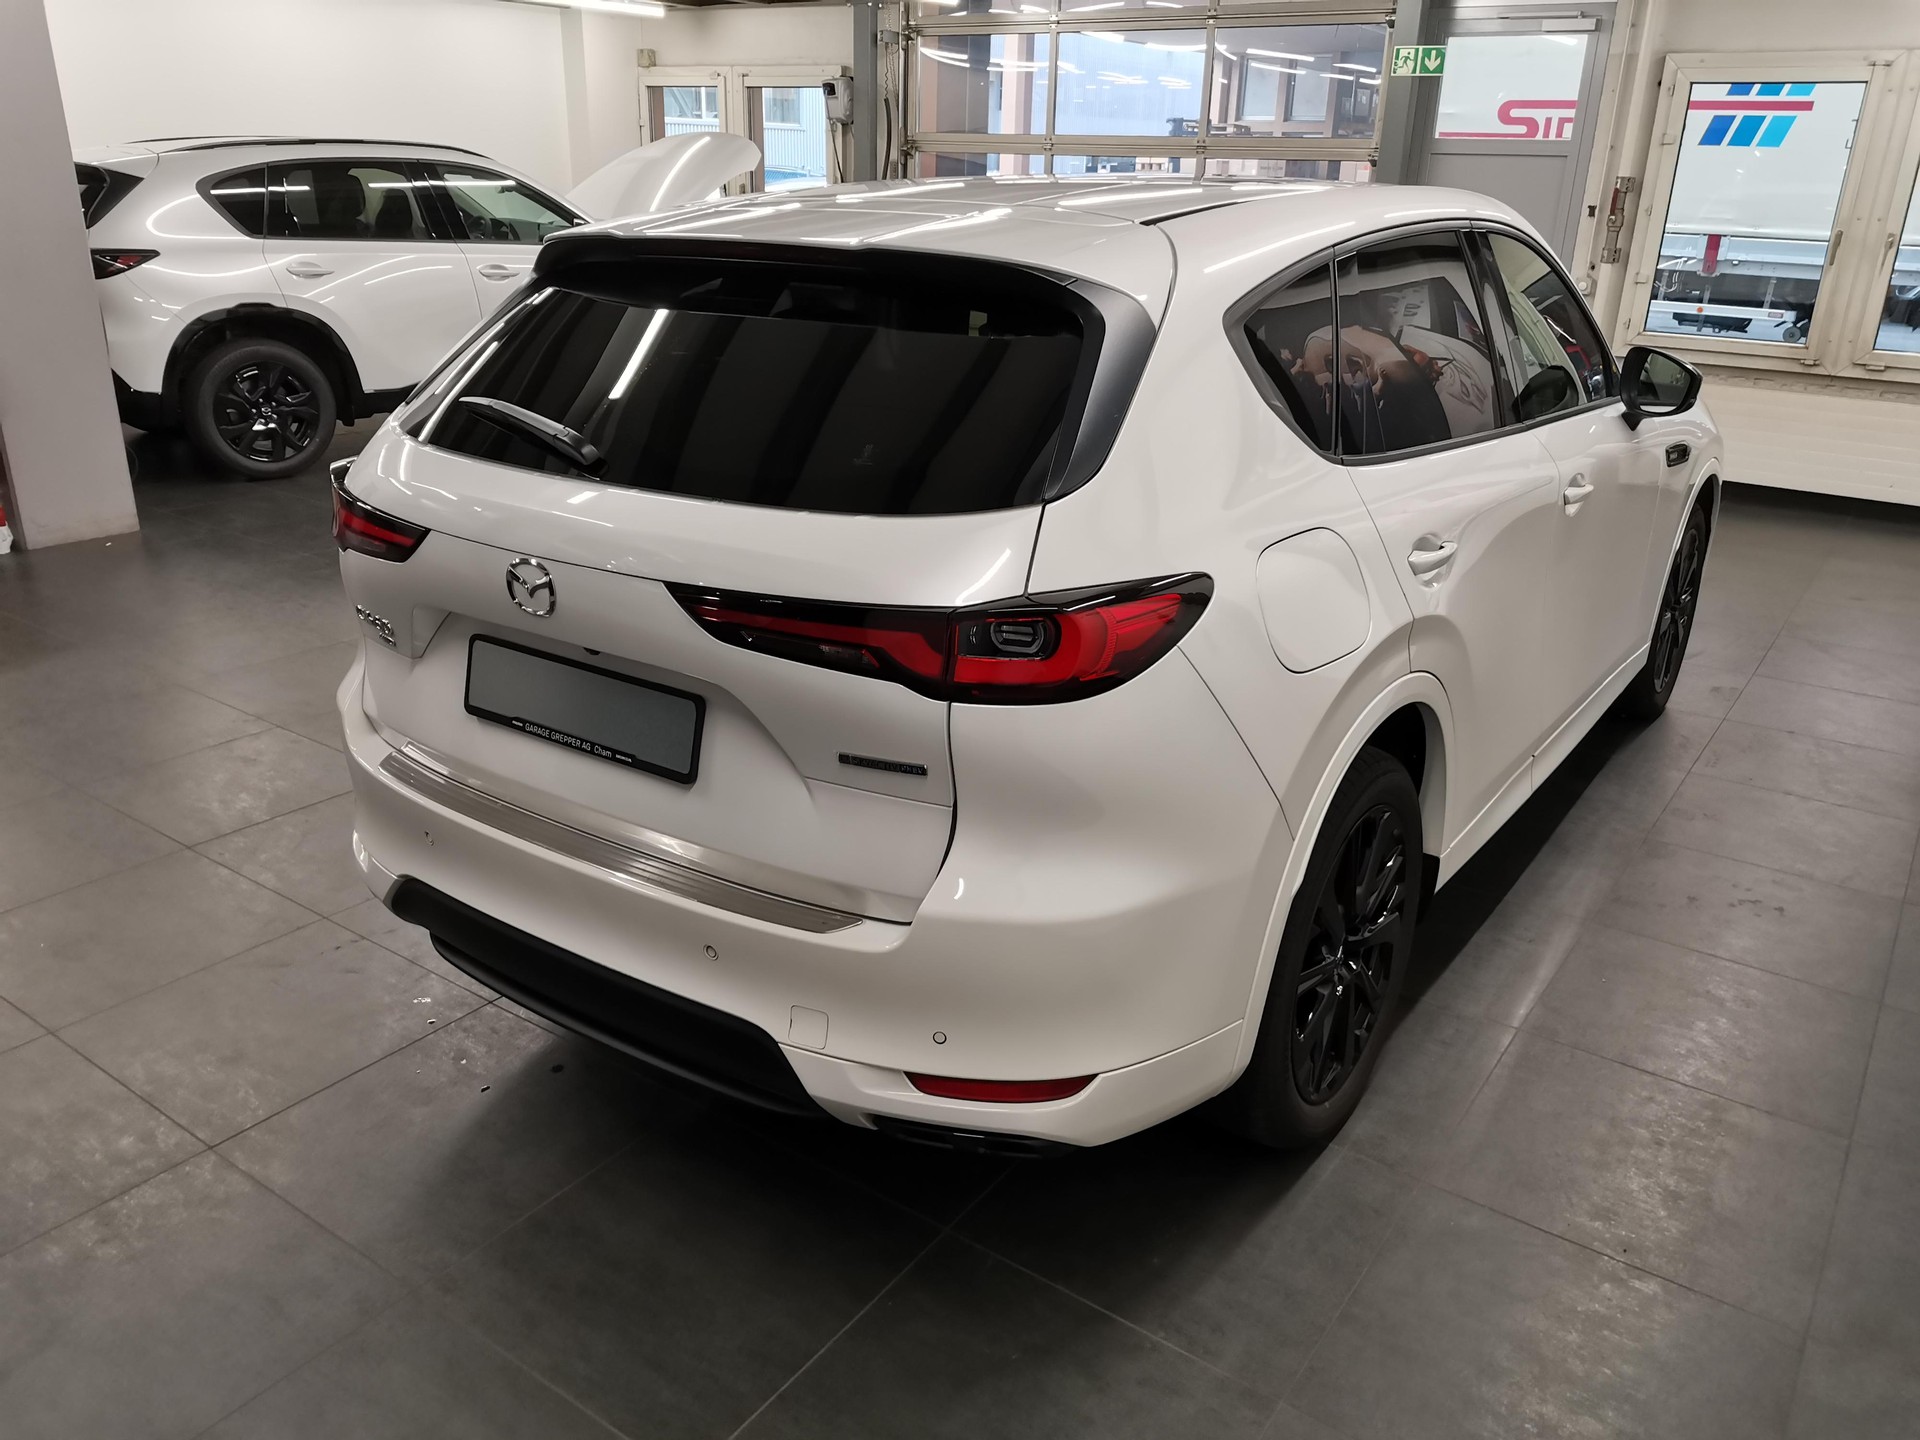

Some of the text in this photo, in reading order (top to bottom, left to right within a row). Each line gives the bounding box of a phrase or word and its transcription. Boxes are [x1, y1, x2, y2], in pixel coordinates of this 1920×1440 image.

[524, 722, 550, 738] GARAGE
[550, 731, 581, 747] GREPPER
[581, 741, 591, 751] AG
[593, 745, 612, 758] Cham
